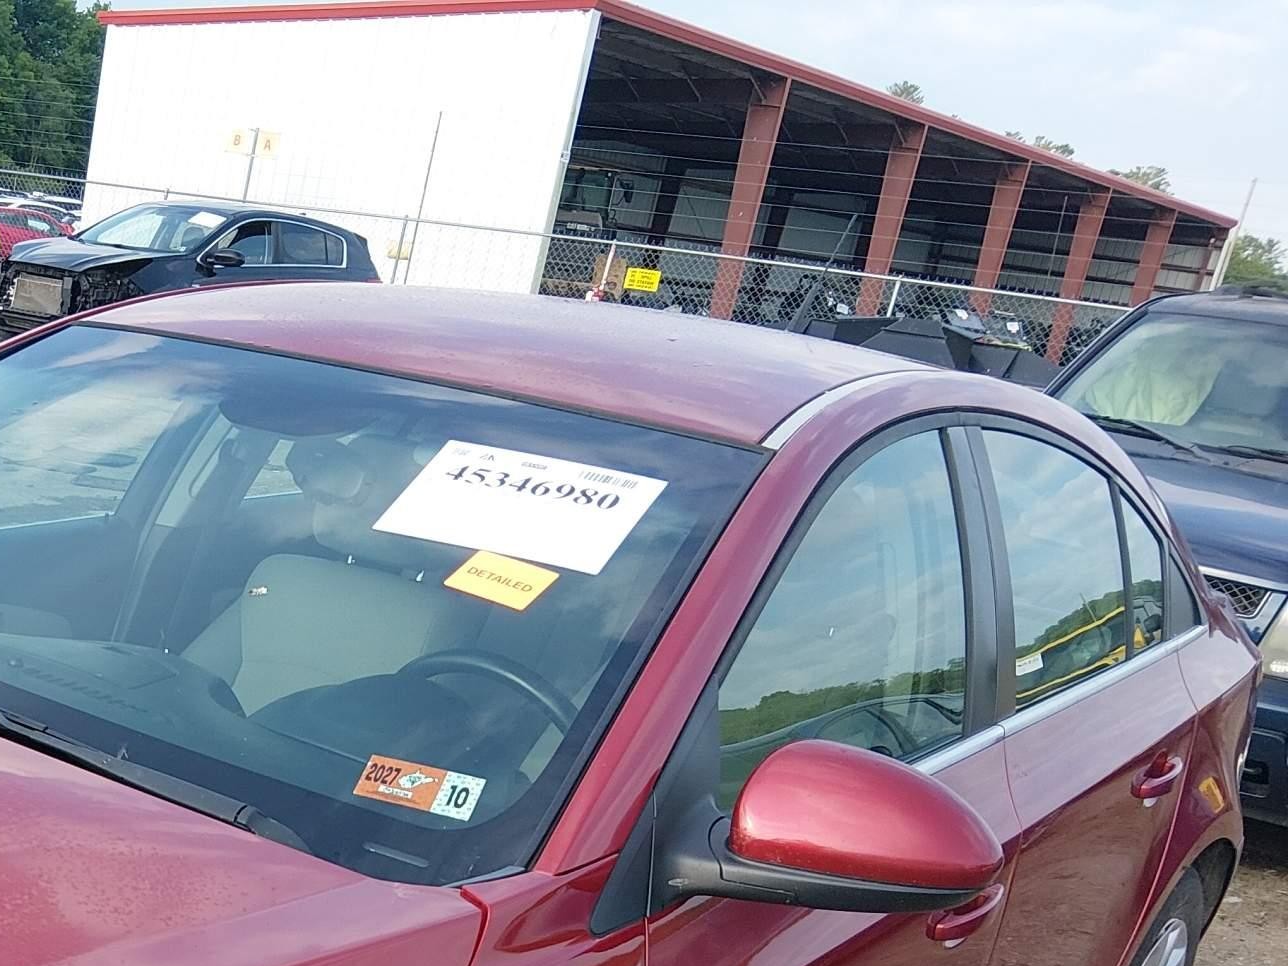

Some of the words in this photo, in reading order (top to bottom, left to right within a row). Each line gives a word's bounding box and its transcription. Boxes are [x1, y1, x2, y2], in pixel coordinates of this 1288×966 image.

[233, 134, 241, 146] B
[263, 139, 271, 152] A
[445, 465, 621, 510] 45346980
[466, 565, 534, 594] DETAILED
[364, 763, 403, 786] 2027
[445, 784, 470, 809] 10
